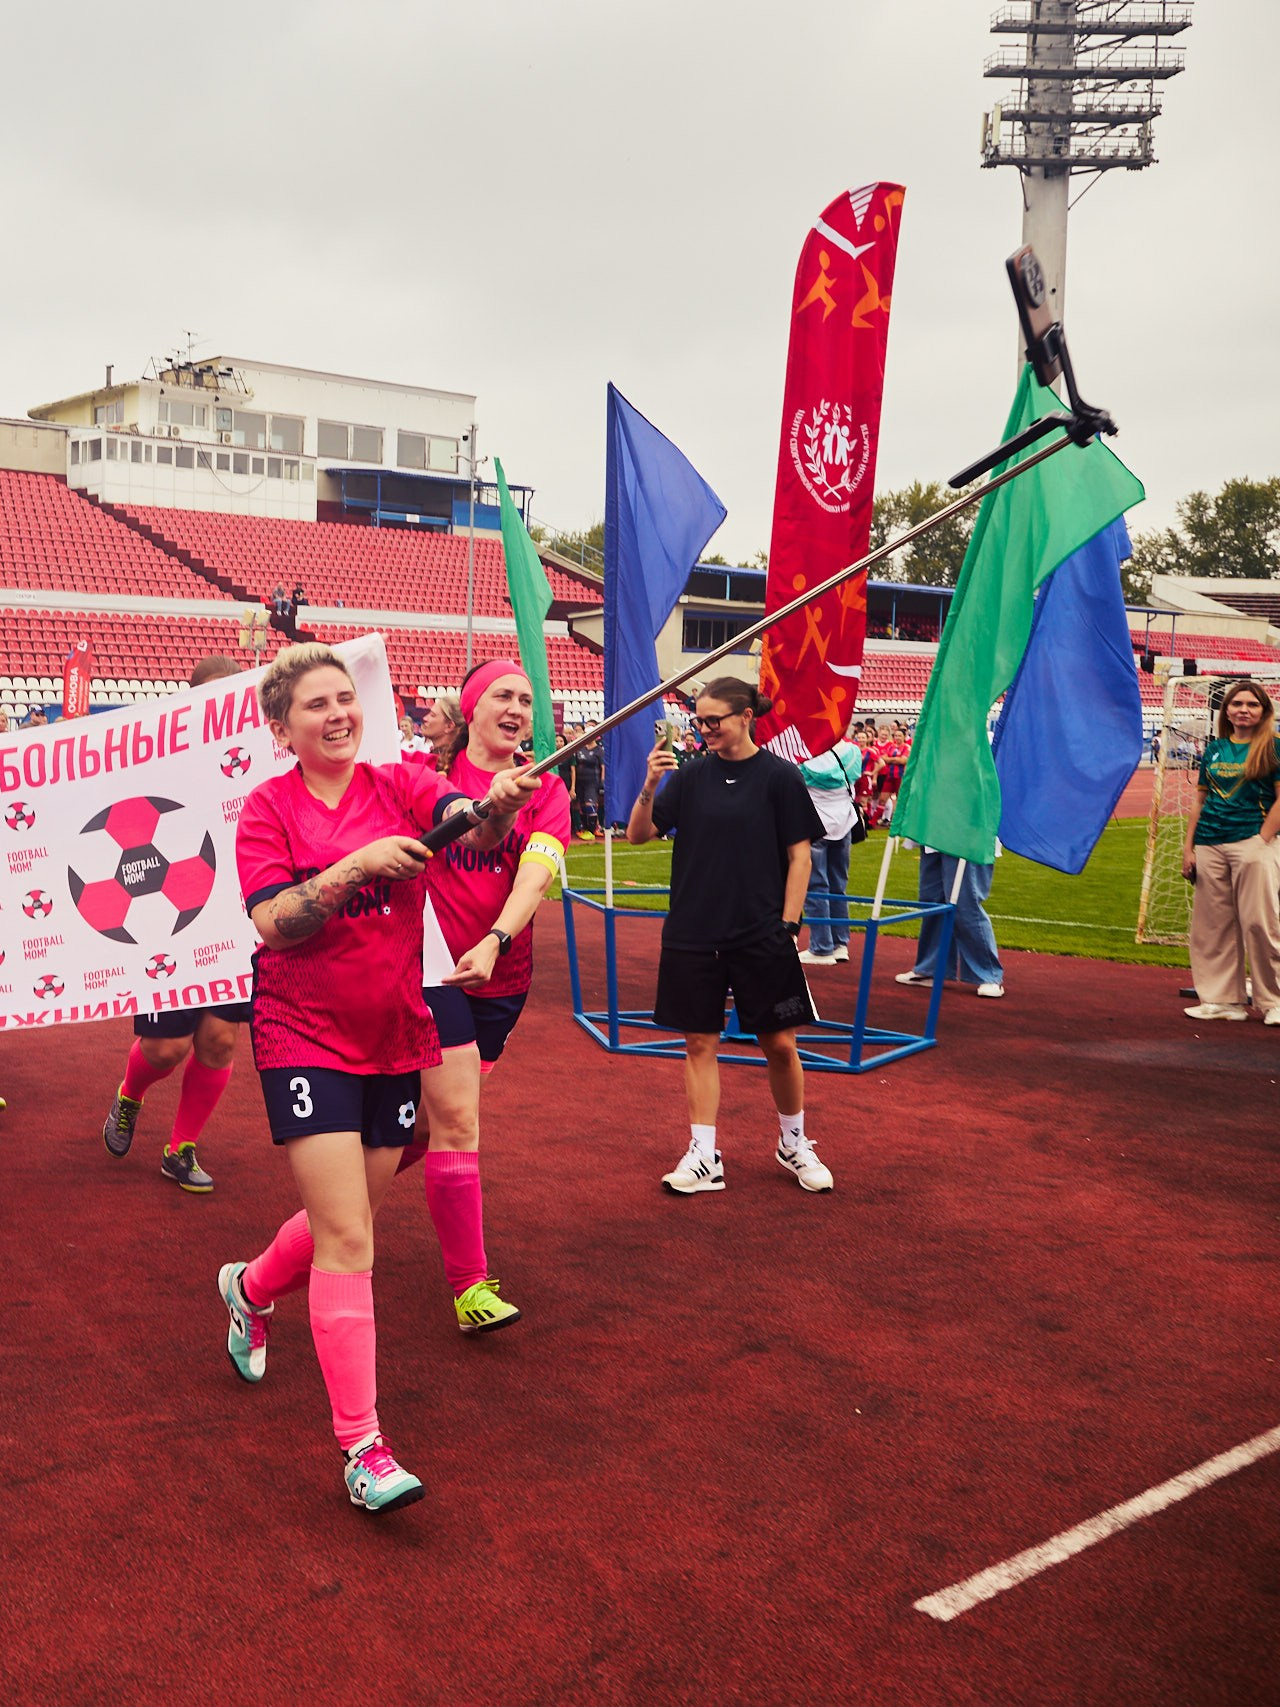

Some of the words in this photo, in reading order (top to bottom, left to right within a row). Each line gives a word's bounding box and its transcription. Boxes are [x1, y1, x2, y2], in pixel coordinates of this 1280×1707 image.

[67, 666, 79, 714] ОСНОВА
[202, 685, 271, 744] МА
[7, 847, 49, 864] FOOTBALL
[9, 861, 33, 875] MOM!
[121, 856, 161, 876] FOOTBALL
[123, 870, 146, 886] MOM!
[22, 934, 65, 950] FOOTBALL
[193, 939, 236, 958] FOOTBALL
[24, 949, 47, 961] MOM!
[195, 954, 219, 968] MOM!
[83, 966, 126, 982] FOOTBALL
[84, 979, 108, 991] MOM!
[289, 1076, 314, 1119] 3
